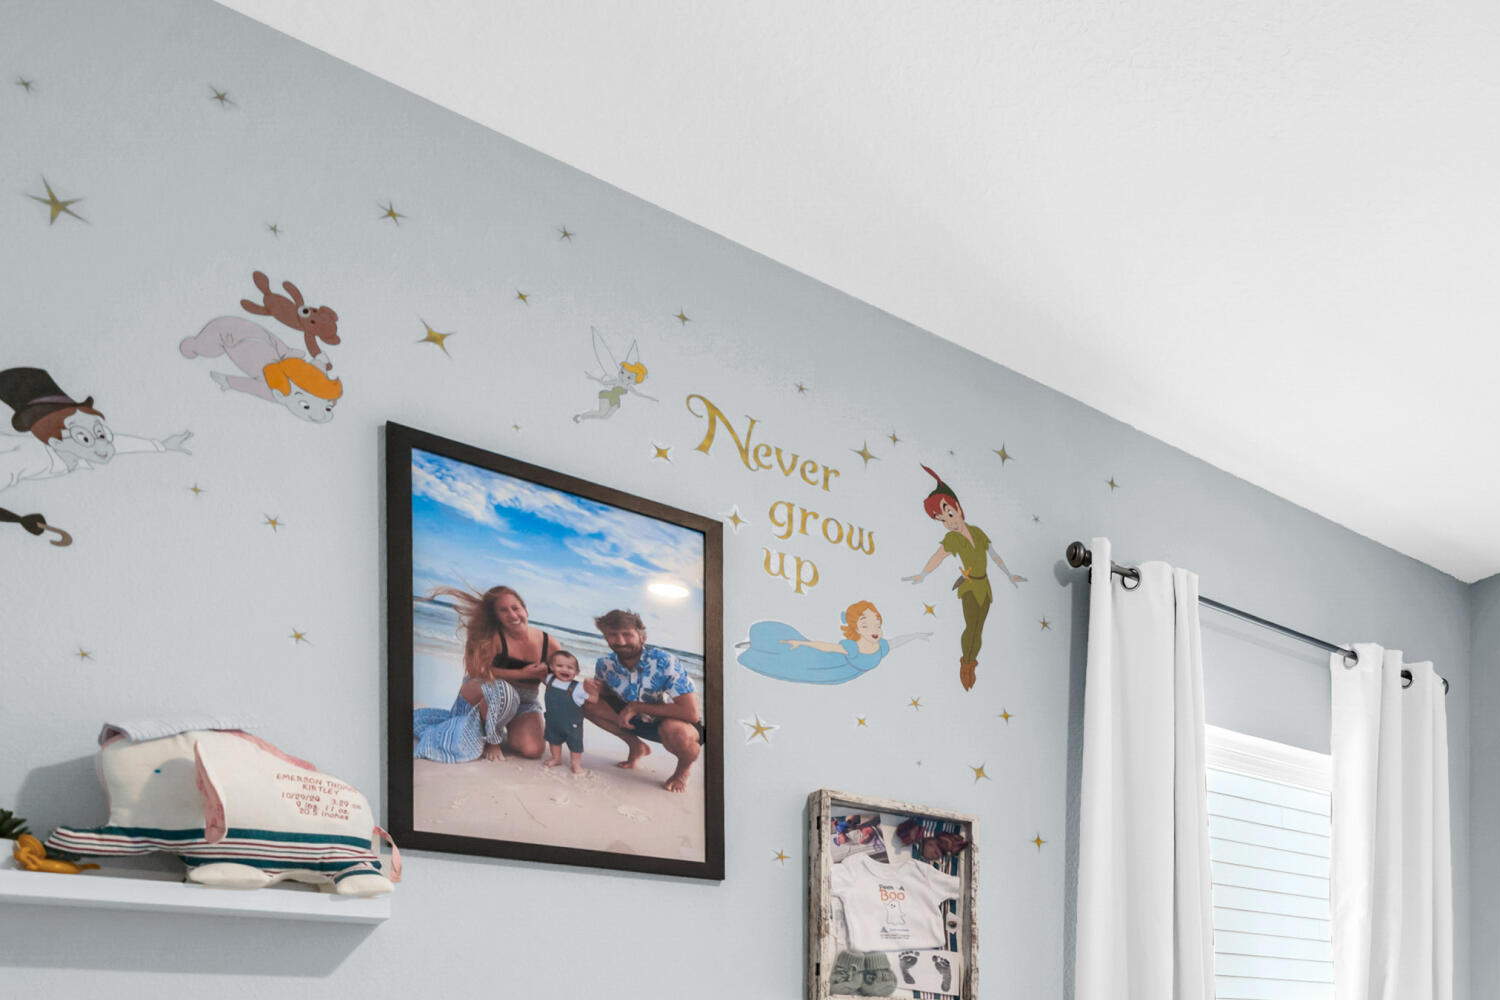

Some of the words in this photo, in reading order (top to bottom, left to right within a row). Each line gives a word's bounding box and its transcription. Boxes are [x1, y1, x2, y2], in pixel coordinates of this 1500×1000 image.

[686, 394, 840, 492] Never
[769, 501, 875, 555] grow
[762, 546, 819, 595] up
